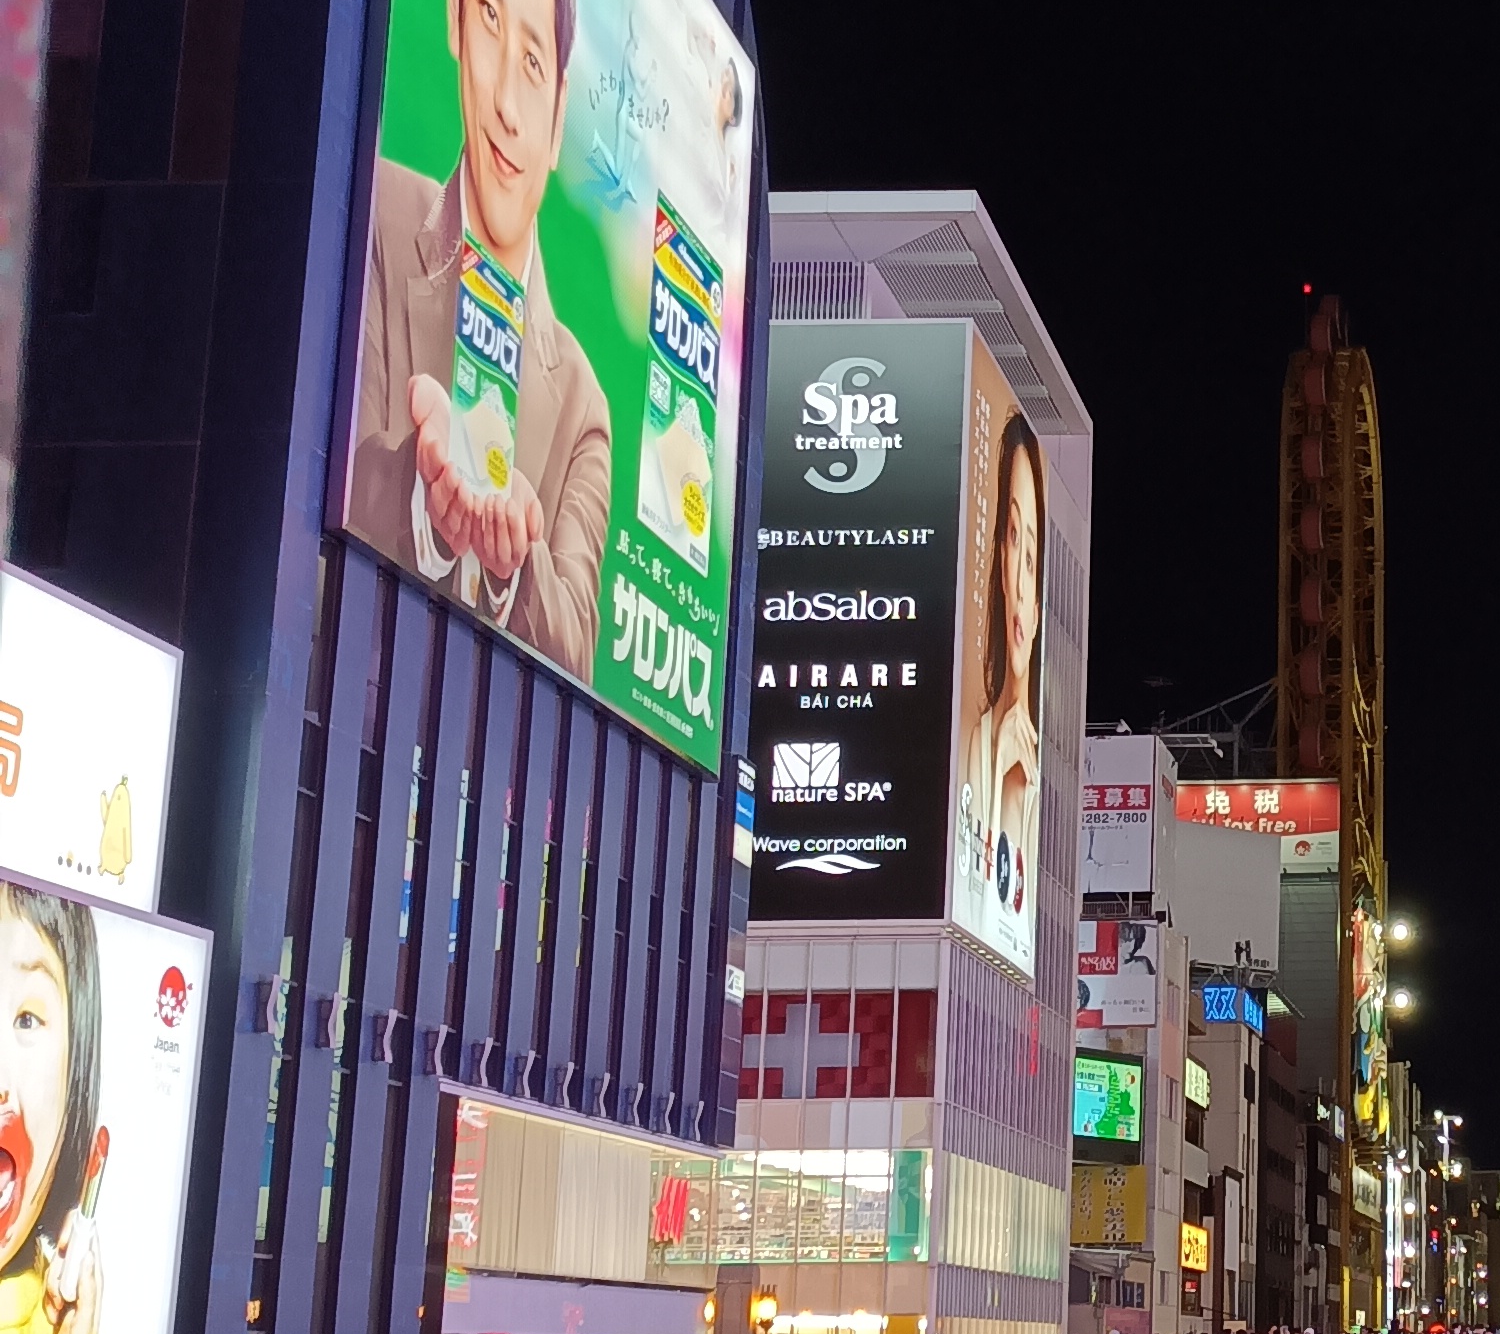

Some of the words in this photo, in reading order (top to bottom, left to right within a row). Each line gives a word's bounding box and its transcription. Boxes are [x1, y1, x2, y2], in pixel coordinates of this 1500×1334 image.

[461, 296, 519, 382] サロンパス
[654, 279, 718, 395] サロンパス
[802, 382, 899, 436] Spa
[795, 433, 903, 451] treatment
[770, 529, 928, 547] BEAUTYLASH
[763, 589, 917, 622] abSalon
[612, 573, 714, 716] サロンパス
[772, 786, 837, 803] nature
[844, 784, 886, 802] SPA
[1205, 789, 1280, 815] 免税
[753, 837, 799, 853] Wave
[804, 835, 906, 854] corporation
[154, 1035, 180, 1054] Japan
